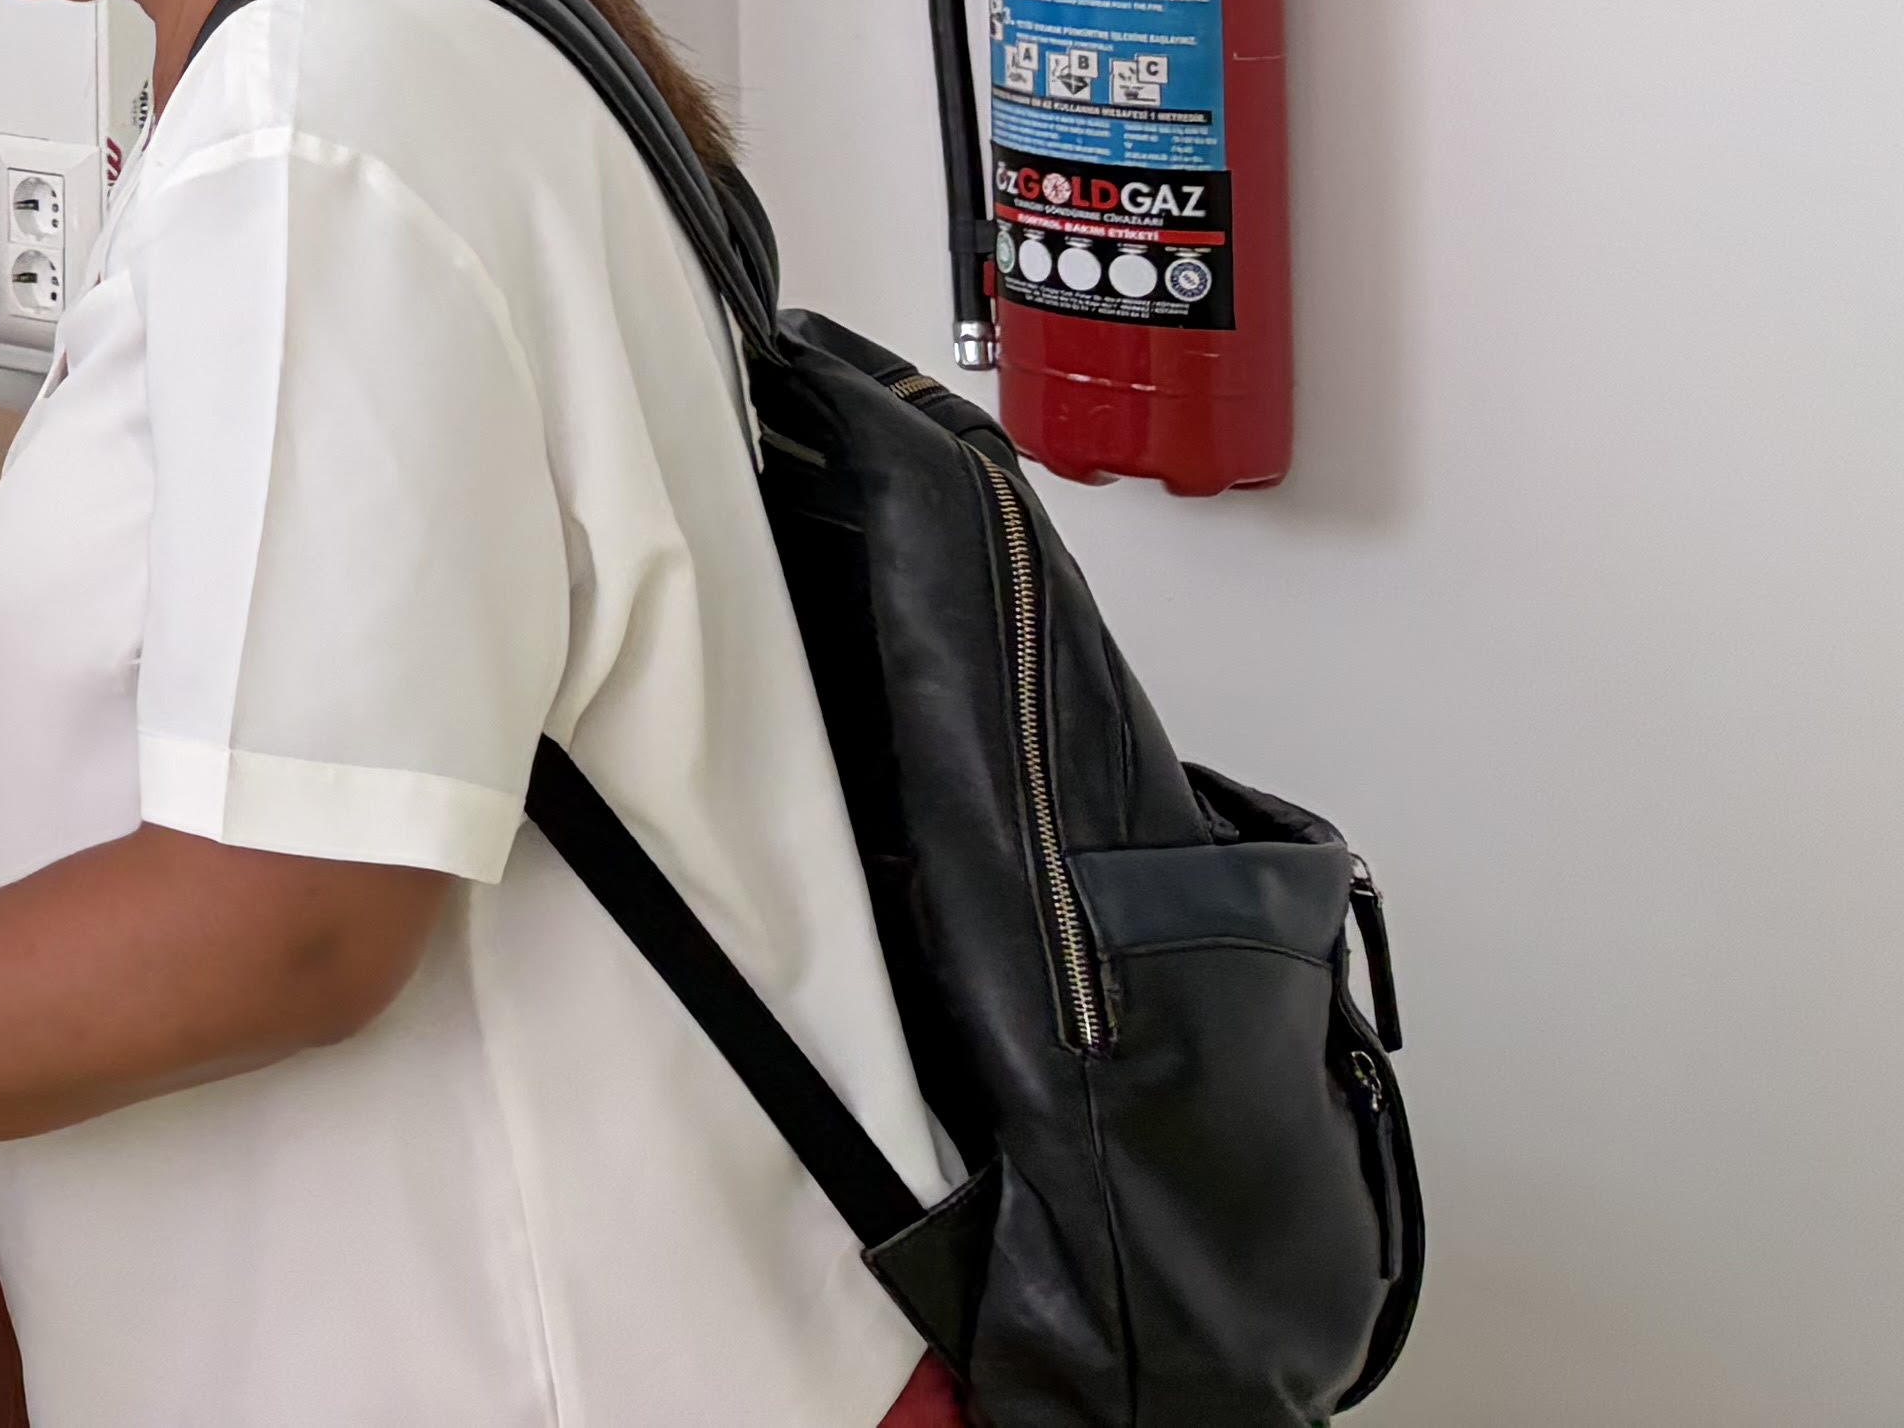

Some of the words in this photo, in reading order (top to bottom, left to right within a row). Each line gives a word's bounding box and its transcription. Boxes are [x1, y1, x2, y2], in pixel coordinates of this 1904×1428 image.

[1023, 48, 1032, 62] A
[1078, 55, 1090, 69] B
[1146, 61, 1159, 76] C
